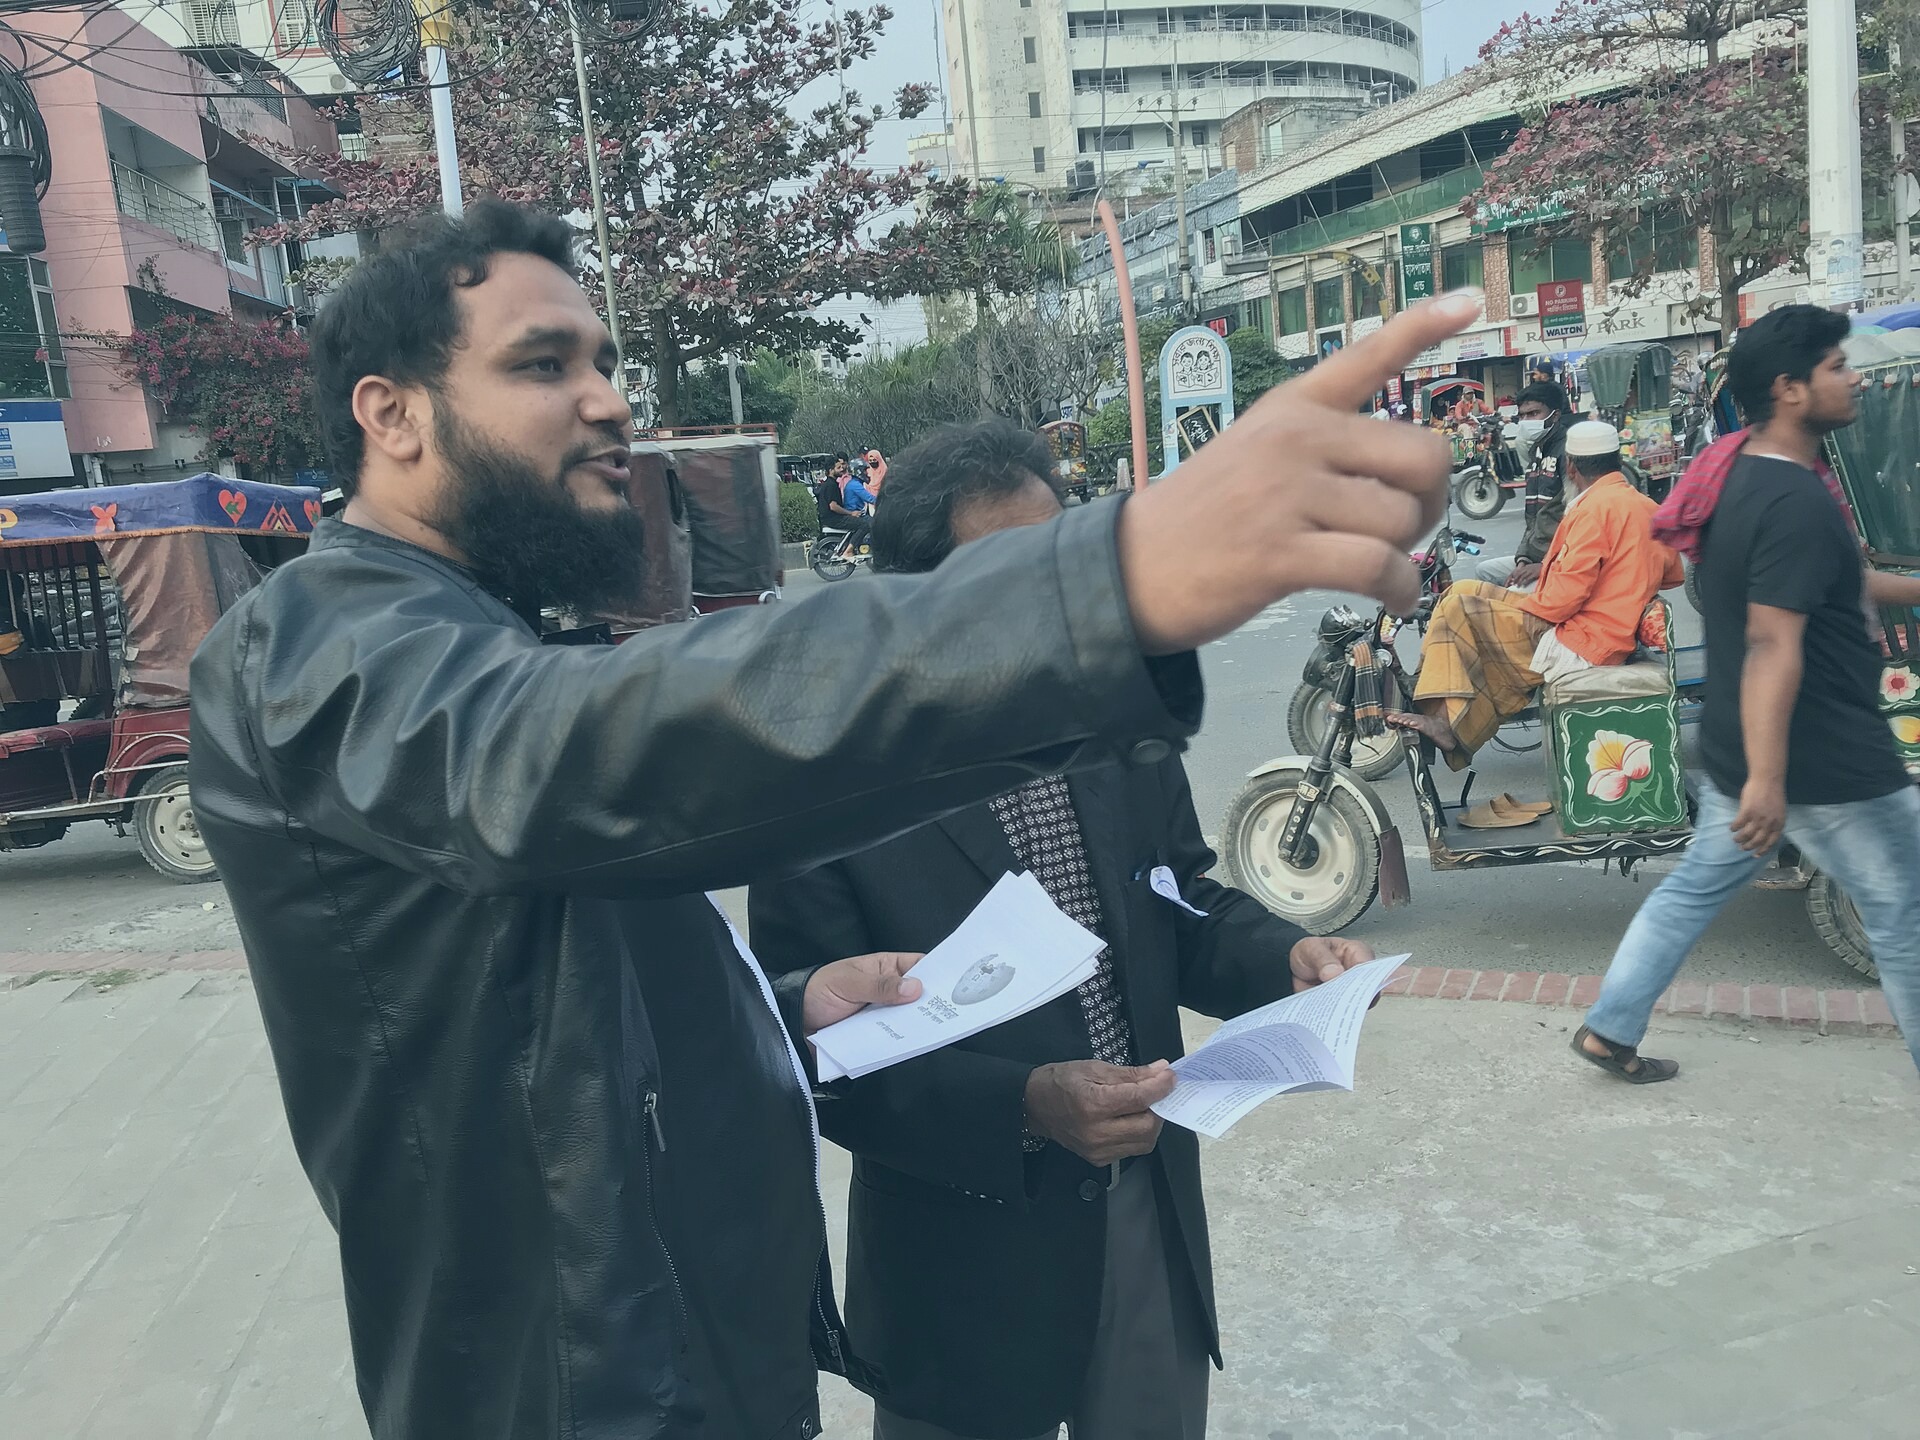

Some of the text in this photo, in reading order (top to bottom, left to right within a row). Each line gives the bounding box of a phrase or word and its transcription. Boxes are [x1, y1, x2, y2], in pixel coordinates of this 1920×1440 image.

[1404, 262, 1432, 277] হাসপাতাল
[1554, 296, 1578, 305] PARKING
[1545, 325, 1583, 337] WALTON
[1597, 316, 1646, 334] PARK
